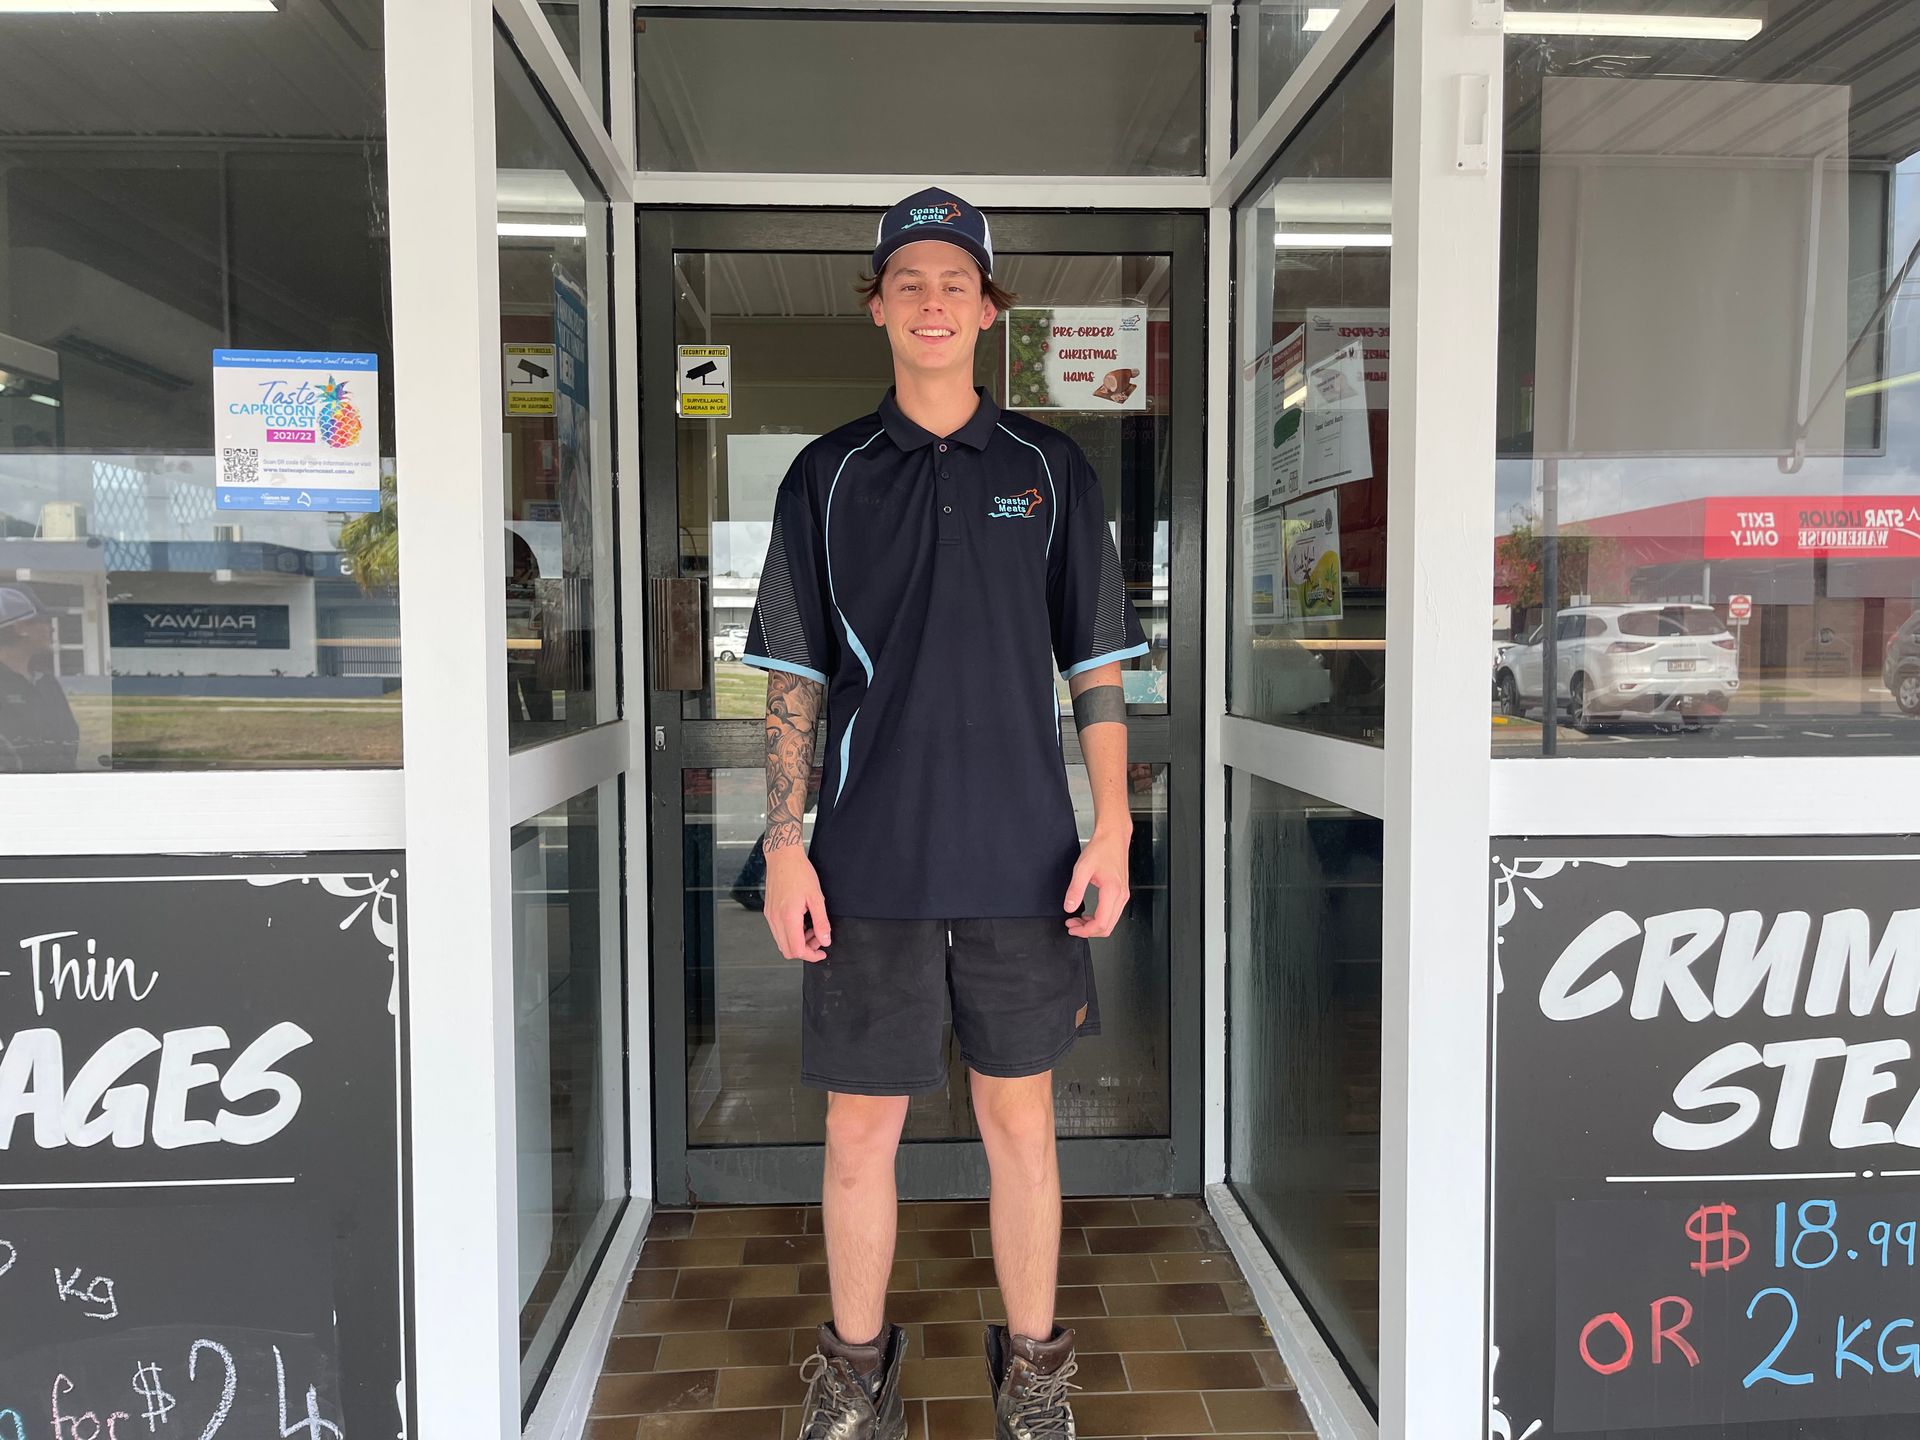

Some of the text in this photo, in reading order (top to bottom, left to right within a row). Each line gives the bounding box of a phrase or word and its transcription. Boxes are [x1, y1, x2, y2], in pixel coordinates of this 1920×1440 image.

[910, 206, 948, 216] Coastal
[913, 213, 944, 222] Meats
[1052, 326, 1115, 338] PRE-ORDER
[1058, 348, 1118, 360] CHRISTMAS
[1063, 371, 1095, 382] HAMS
[259, 381, 318, 406] Taste
[228, 403, 316, 417] CAPRICORN
[265, 415, 316, 428] COAST
[272, 431, 312, 441] 2021/22
[994, 496, 1029, 506] Coastal
[998, 504, 1027, 513] Meats
[20, 930, 159, 1016] Thin
[0, 1020, 314, 1150] AGES
[1579, 1287, 1920, 1388] OR 2 KG
[50, 1373, 130, 1440] for
